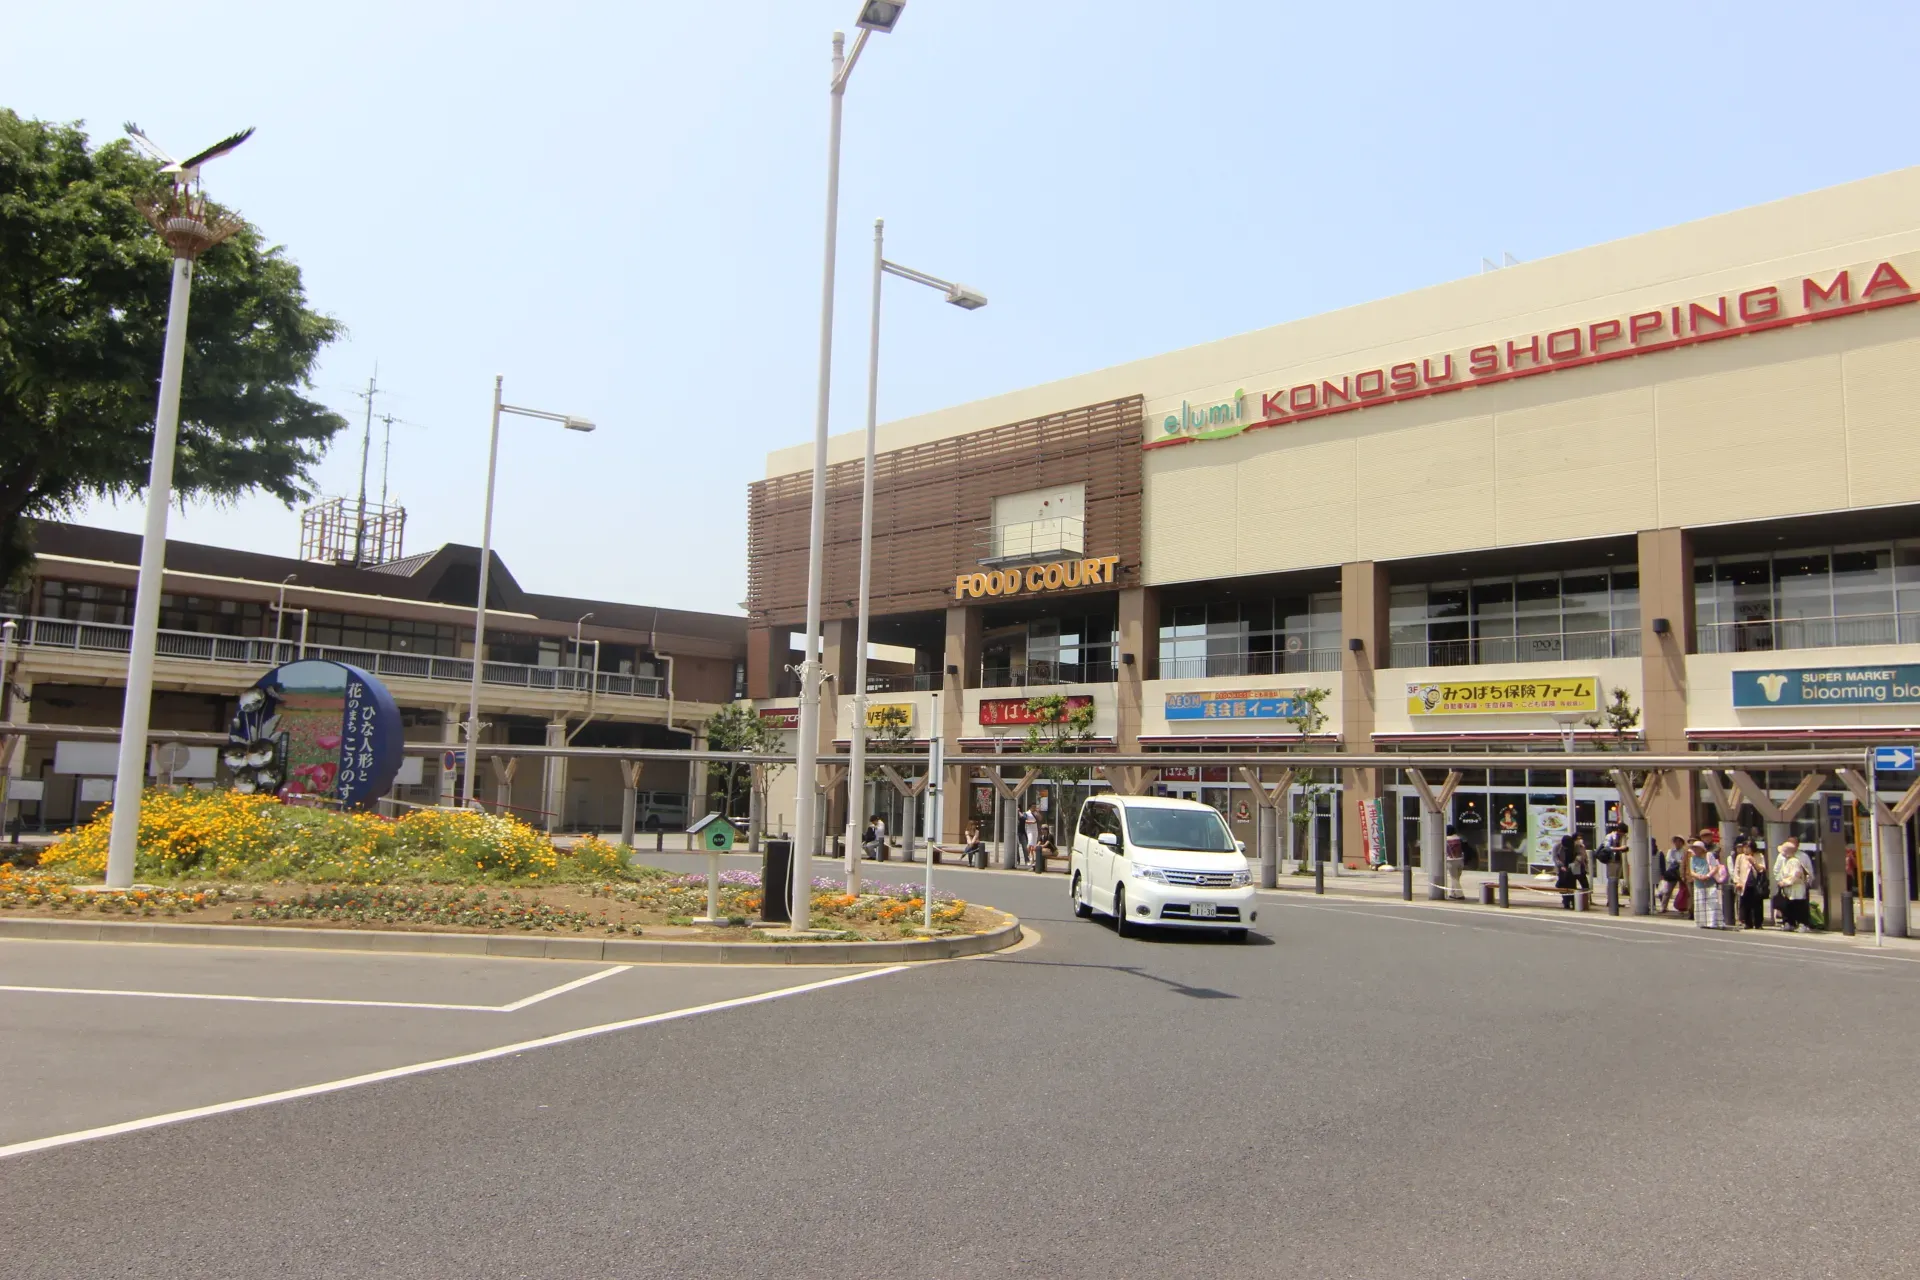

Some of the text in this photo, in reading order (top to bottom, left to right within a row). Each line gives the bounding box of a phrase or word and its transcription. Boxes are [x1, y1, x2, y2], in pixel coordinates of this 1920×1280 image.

[1261, 354, 1452, 417] KONOSU
[1469, 286, 1780, 375] SHOPPING
[1163, 388, 1245, 434] elumi
[955, 554, 1121, 600] FOOD COURT
[1407, 686, 1419, 694] 3F
[1443, 683, 1591, 700] みつばち保険ファーム
[1802, 670, 1897, 682] SUPER MARKET
[1802, 683, 1887, 701] blooming
[1167, 695, 1201, 708] AEON
[339, 682, 362, 800] 花のまち こうのす
[358, 706, 376, 781] ひな人形と
